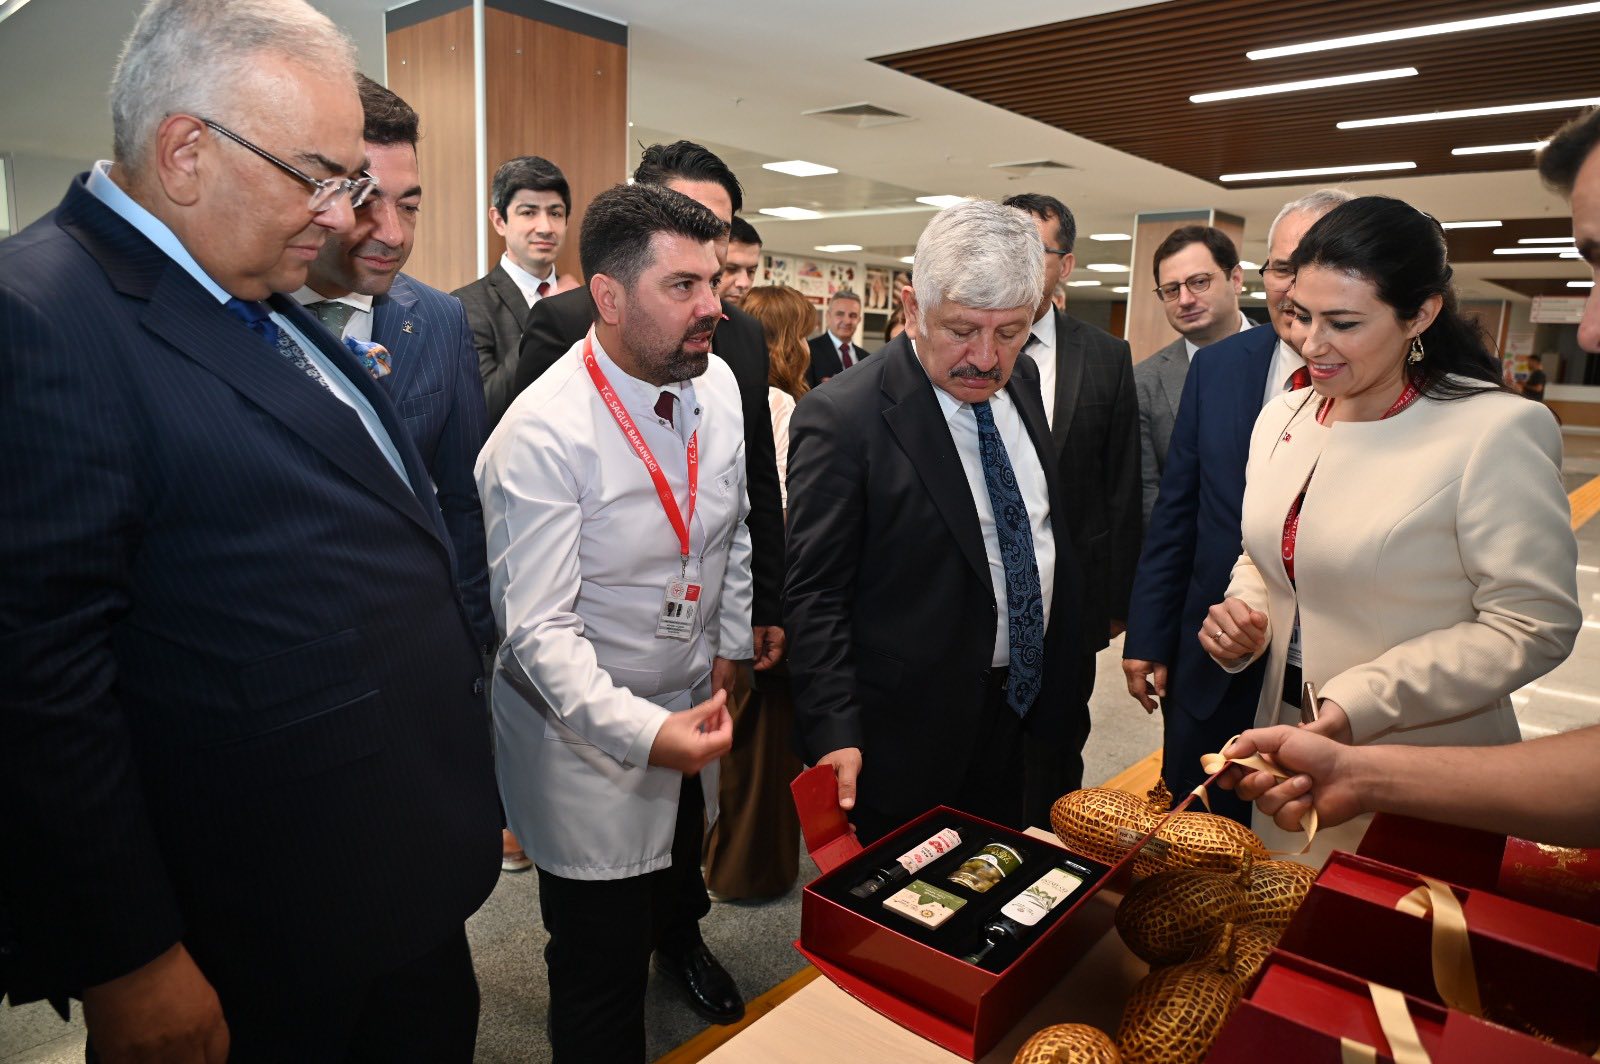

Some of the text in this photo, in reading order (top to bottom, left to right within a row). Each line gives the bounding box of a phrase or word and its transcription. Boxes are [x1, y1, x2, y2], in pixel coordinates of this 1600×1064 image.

[601, 385, 658, 473] T.C. SAĞLIK BAKANLIĞI
[689, 450, 697, 465] T.C.
